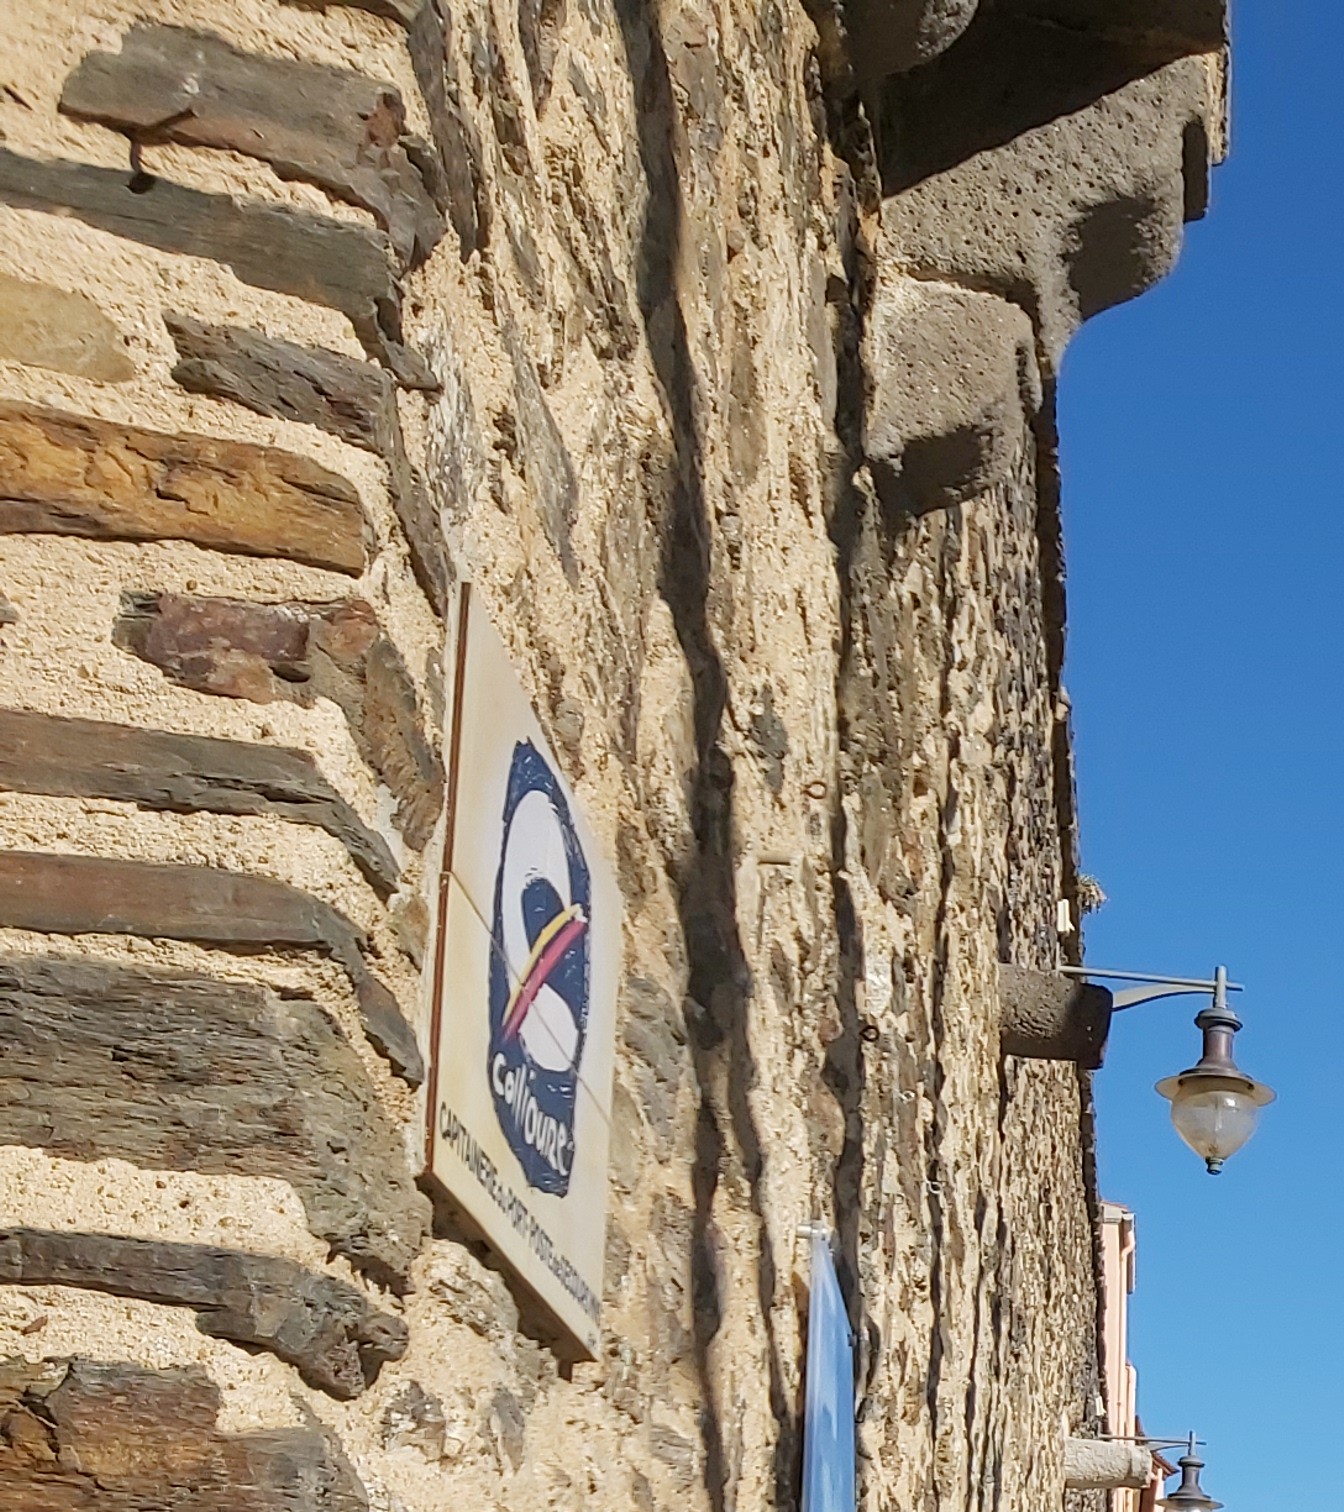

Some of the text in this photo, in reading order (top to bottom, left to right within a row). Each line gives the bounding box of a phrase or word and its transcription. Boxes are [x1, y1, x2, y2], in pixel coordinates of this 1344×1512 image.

[440, 1101, 498, 1201] CAPITAINERIE
[507, 1186, 527, 1239] PORT
[529, 1214, 553, 1270] POSTE
